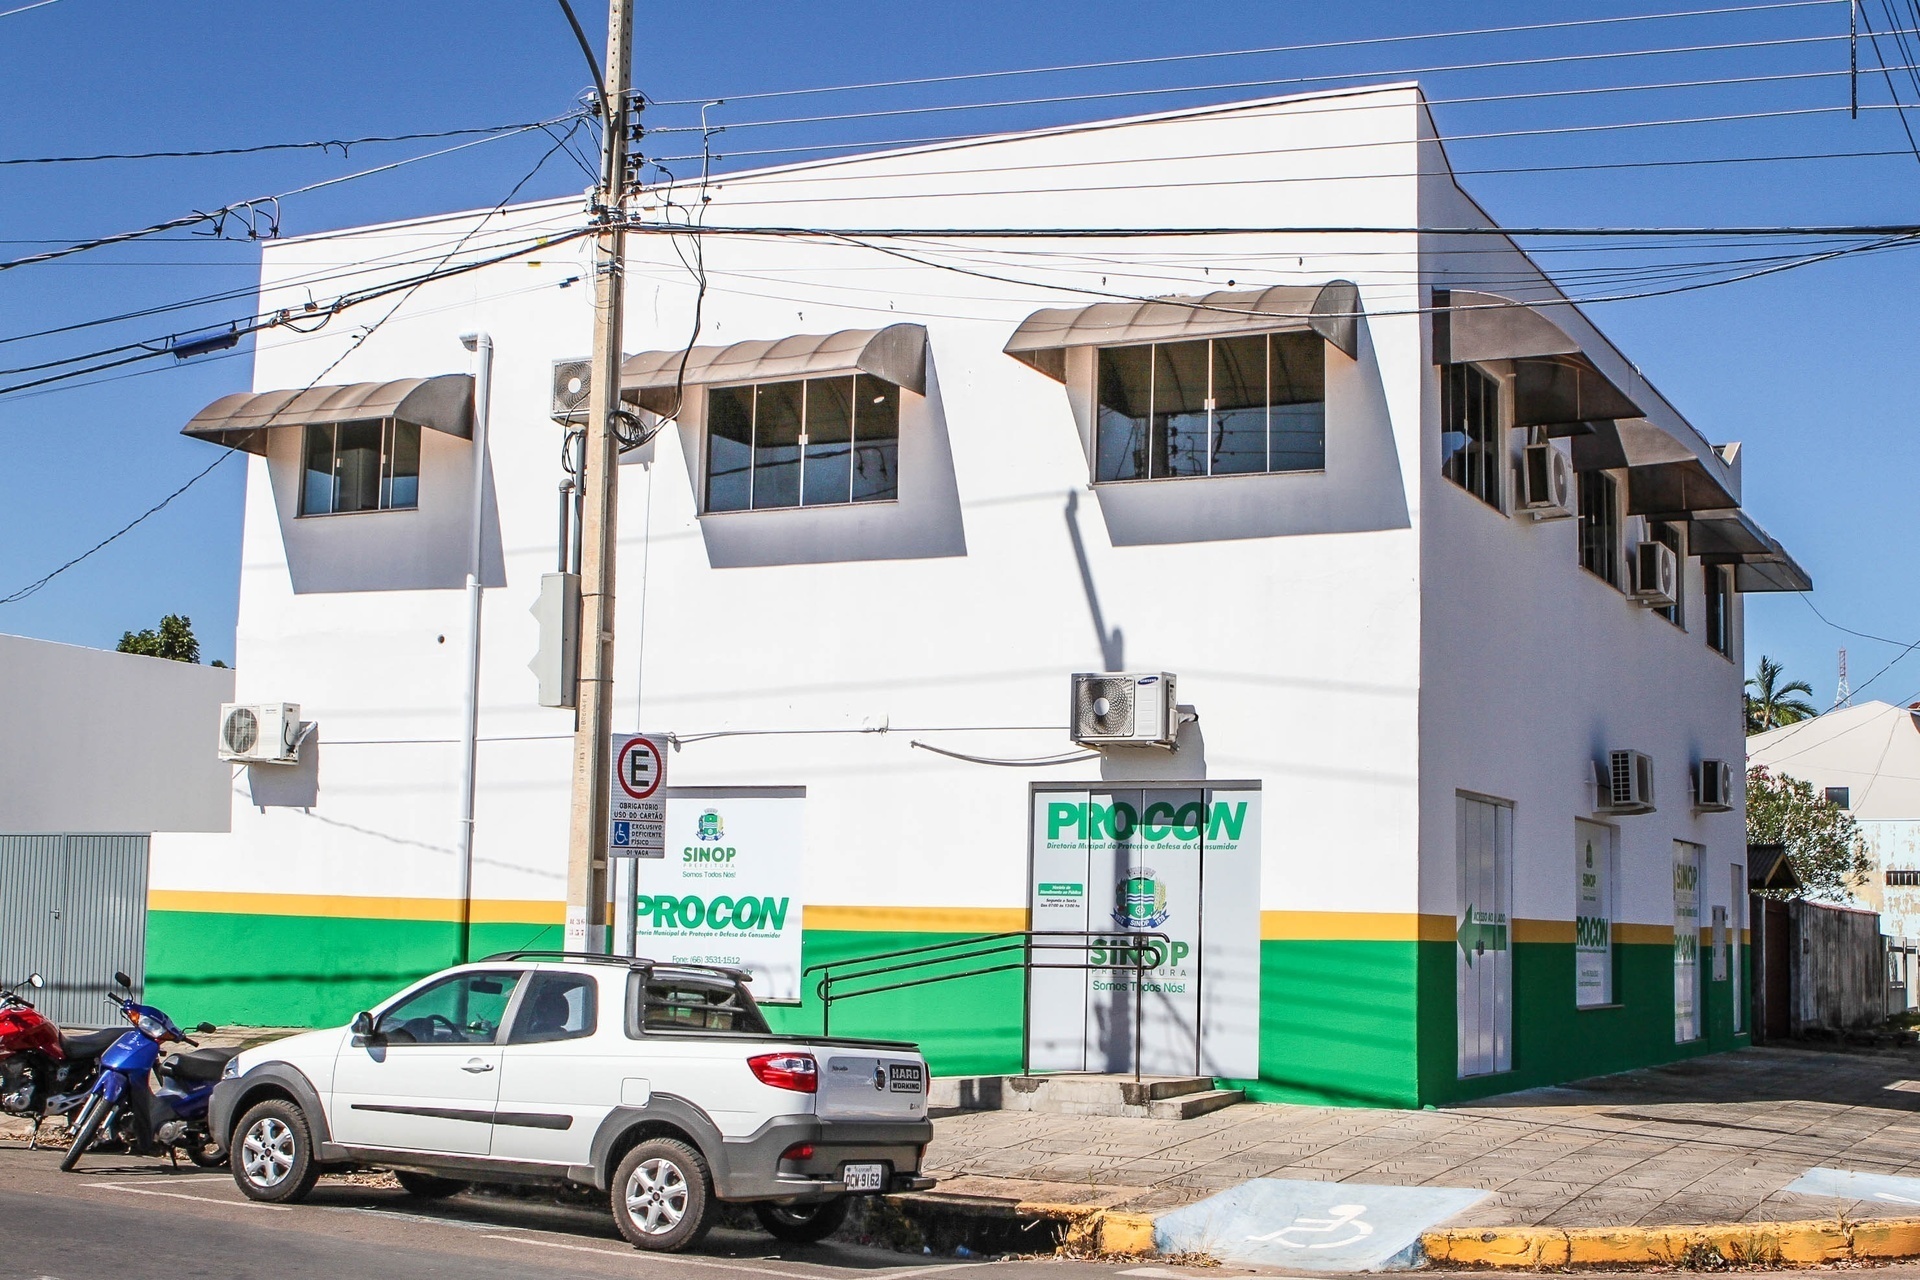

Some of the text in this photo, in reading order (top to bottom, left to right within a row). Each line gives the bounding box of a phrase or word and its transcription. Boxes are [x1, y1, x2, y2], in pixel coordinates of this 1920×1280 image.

[631, 750, 649, 787] E
[619, 802, 659, 811] OBRIGATÓRIO
[614, 811, 628, 819] USO
[639, 811, 663, 820] CARTÃO
[1048, 802, 1248, 841] PROCON
[1157, 842, 1181, 850] Defesa
[1182, 842, 1192, 850] do
[683, 847, 736, 862] SINOP
[1677, 863, 1697, 891] SINOP
[637, 895, 790, 931] PROCON
[719, 930, 738, 938] Defesa
[748, 931, 781, 939] Consumidor
[1576, 916, 1608, 947] ROCON
[1090, 939, 1189, 966] SINOP
[1675, 934, 1697, 960] ROCON
[672, 955, 740, 965] Fone: (66) 3531-1512
[1091, 968, 1187, 977] PREFETURA
[1093, 981, 1186, 993] Somos Tdos Nós!
[892, 1068, 919, 1080] HARD
[892, 1082, 919, 1090] WORKING
